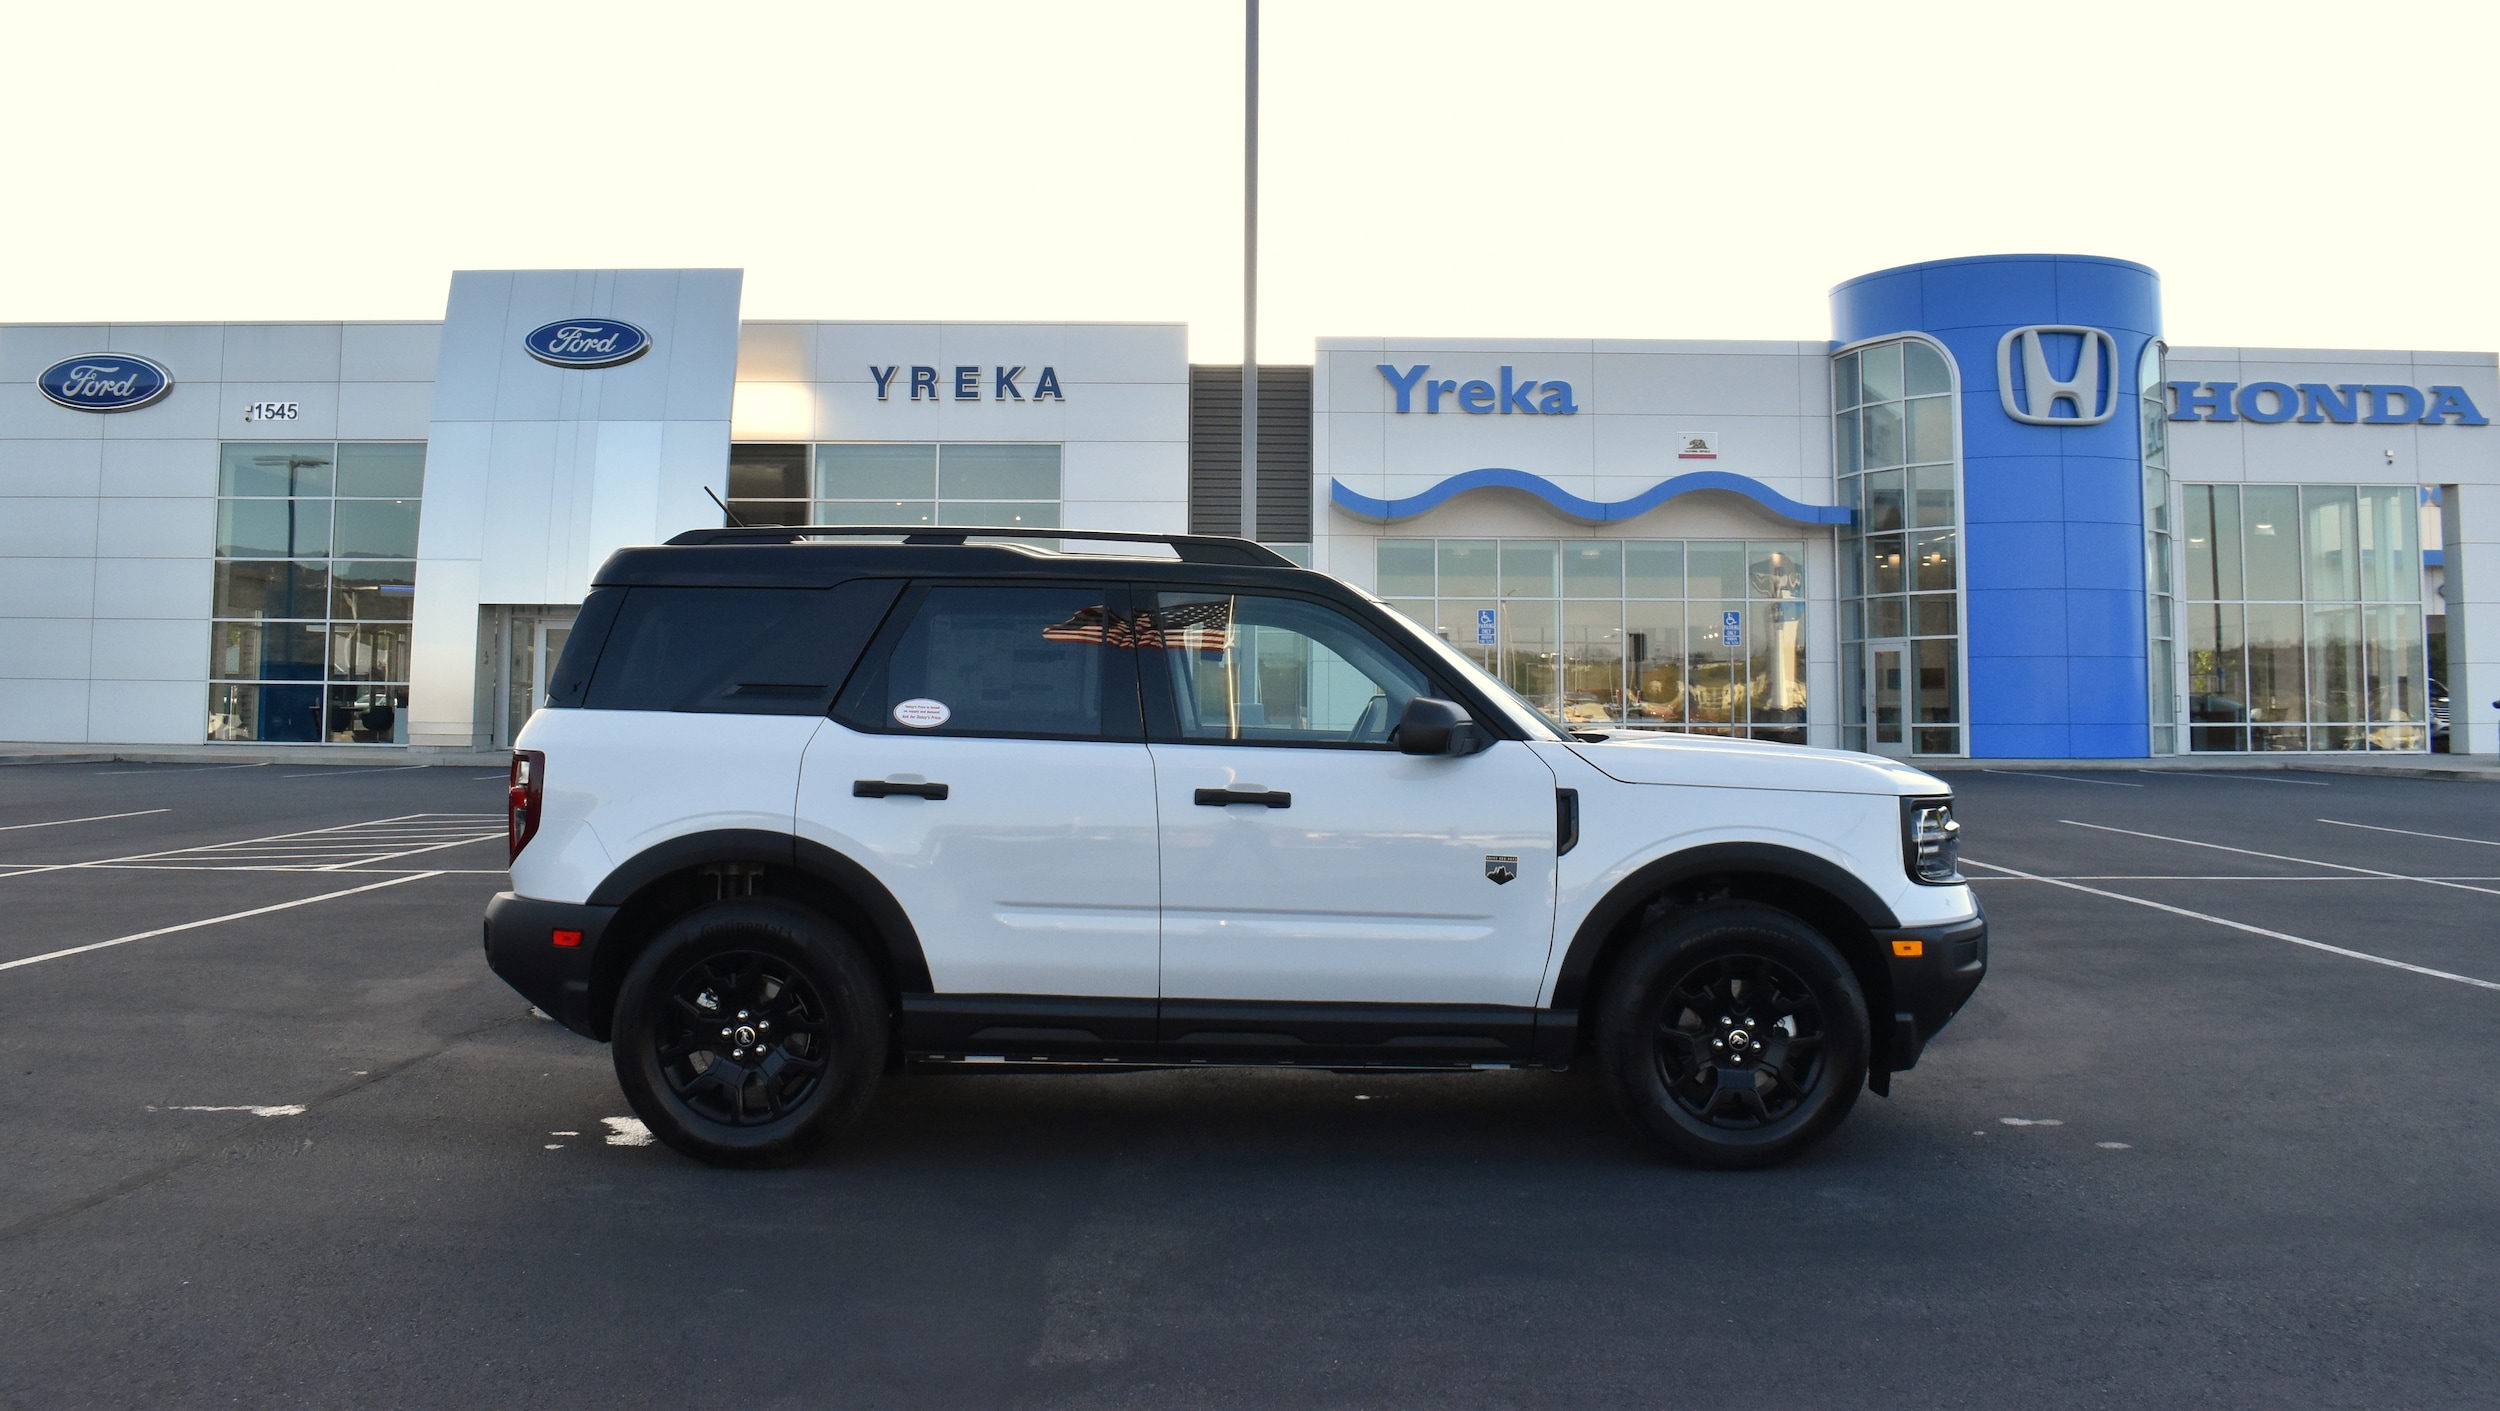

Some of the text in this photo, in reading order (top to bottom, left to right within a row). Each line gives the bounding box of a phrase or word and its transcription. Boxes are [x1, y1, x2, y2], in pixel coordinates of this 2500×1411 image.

[548, 326, 620, 353] Ford
[62, 365, 138, 397] Ford
[868, 365, 1066, 401] YREKA
[1376, 364, 1579, 415] Yreka
[255, 403, 298, 420] 1545
[2167, 380, 2490, 426] HONDA
